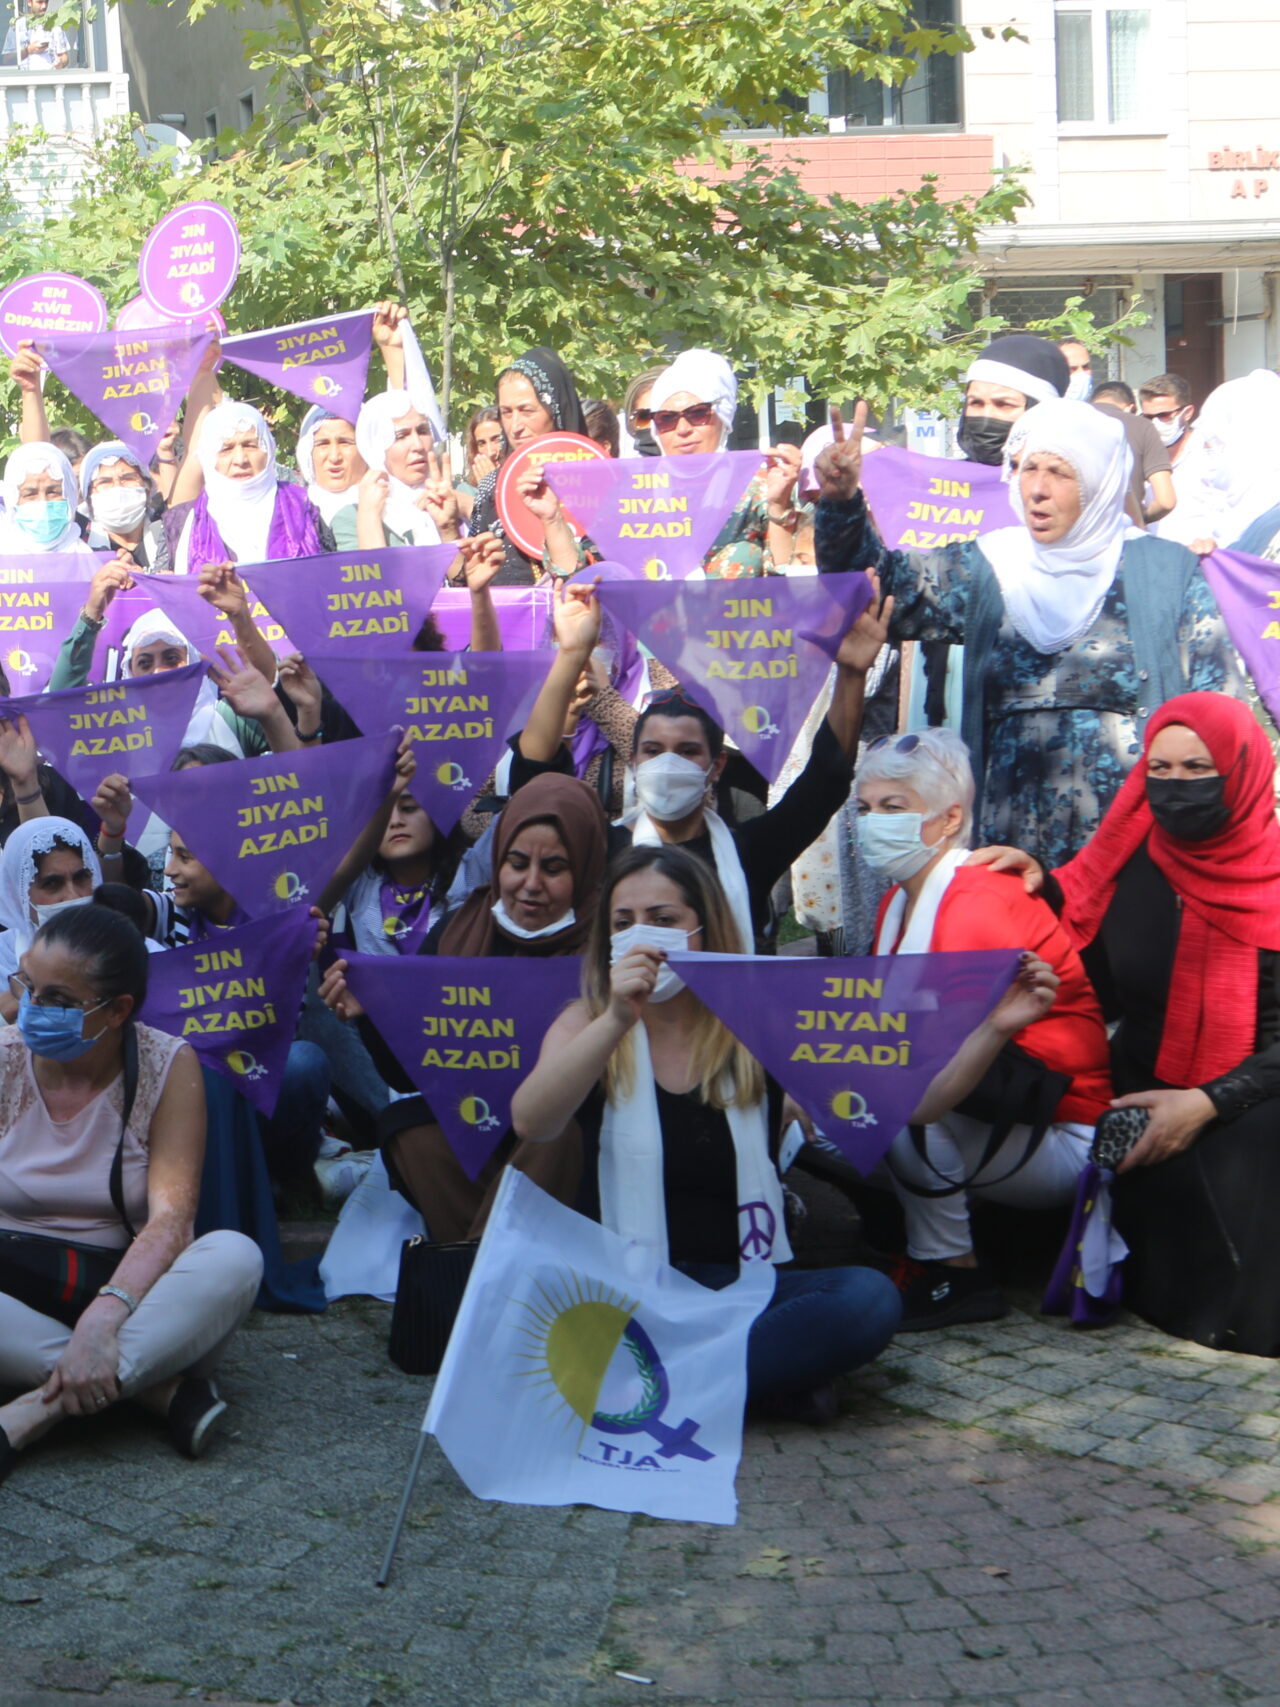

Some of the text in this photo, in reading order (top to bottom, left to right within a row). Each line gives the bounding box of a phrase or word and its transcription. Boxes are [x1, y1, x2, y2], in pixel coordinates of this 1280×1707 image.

[180, 223, 205, 240] JIN
[169, 240, 215, 260] JIYAN
[167, 257, 216, 280] AZADÎ
[42, 286, 67, 301] EM
[4, 311, 94, 333] DIPARÊZIN
[114, 340, 148, 358] JIN
[277, 326, 338, 352] JIYAN
[281, 339, 347, 372] AZADÎ
[102, 356, 167, 380] JIYAN
[102, 376, 170, 400] AZADÎ
[631, 472, 670, 490] JIN
[928, 477, 971, 499] JIN
[618, 497, 688, 514] JIYAN
[906, 501, 985, 526] JIYAN
[618, 517, 693, 538] AZADÎ
[340, 563, 382, 582] JIN
[326, 589, 403, 611] JIYAN
[723, 597, 772, 618] JIN
[328, 612, 410, 638] AZADÎ
[705, 628, 793, 648] JIYAN
[422, 669, 468, 686] JIN
[705, 654, 799, 680] AZADÎ
[85, 686, 127, 705] JIN
[405, 695, 489, 714] JIYAN
[69, 704, 147, 730] JIYAN
[406, 718, 495, 741] AZADÎ
[71, 727, 154, 756] AZADÎ
[250, 773, 300, 795] JIN
[237, 796, 324, 828] JIYAN
[238, 818, 329, 859] AZADÎ
[193, 948, 243, 974] JIN
[178, 976, 266, 1009] JIYAN
[441, 985, 491, 1006] JIN
[822, 977, 883, 999] JIN
[182, 1003, 278, 1037] AZADÎ
[422, 1016, 516, 1039] JIYAN
[795, 1009, 907, 1033] JIYAN
[422, 1045, 521, 1069] AZADÎ
[789, 1041, 912, 1067] AZADÎ
[598, 1440, 663, 1469] TJA
